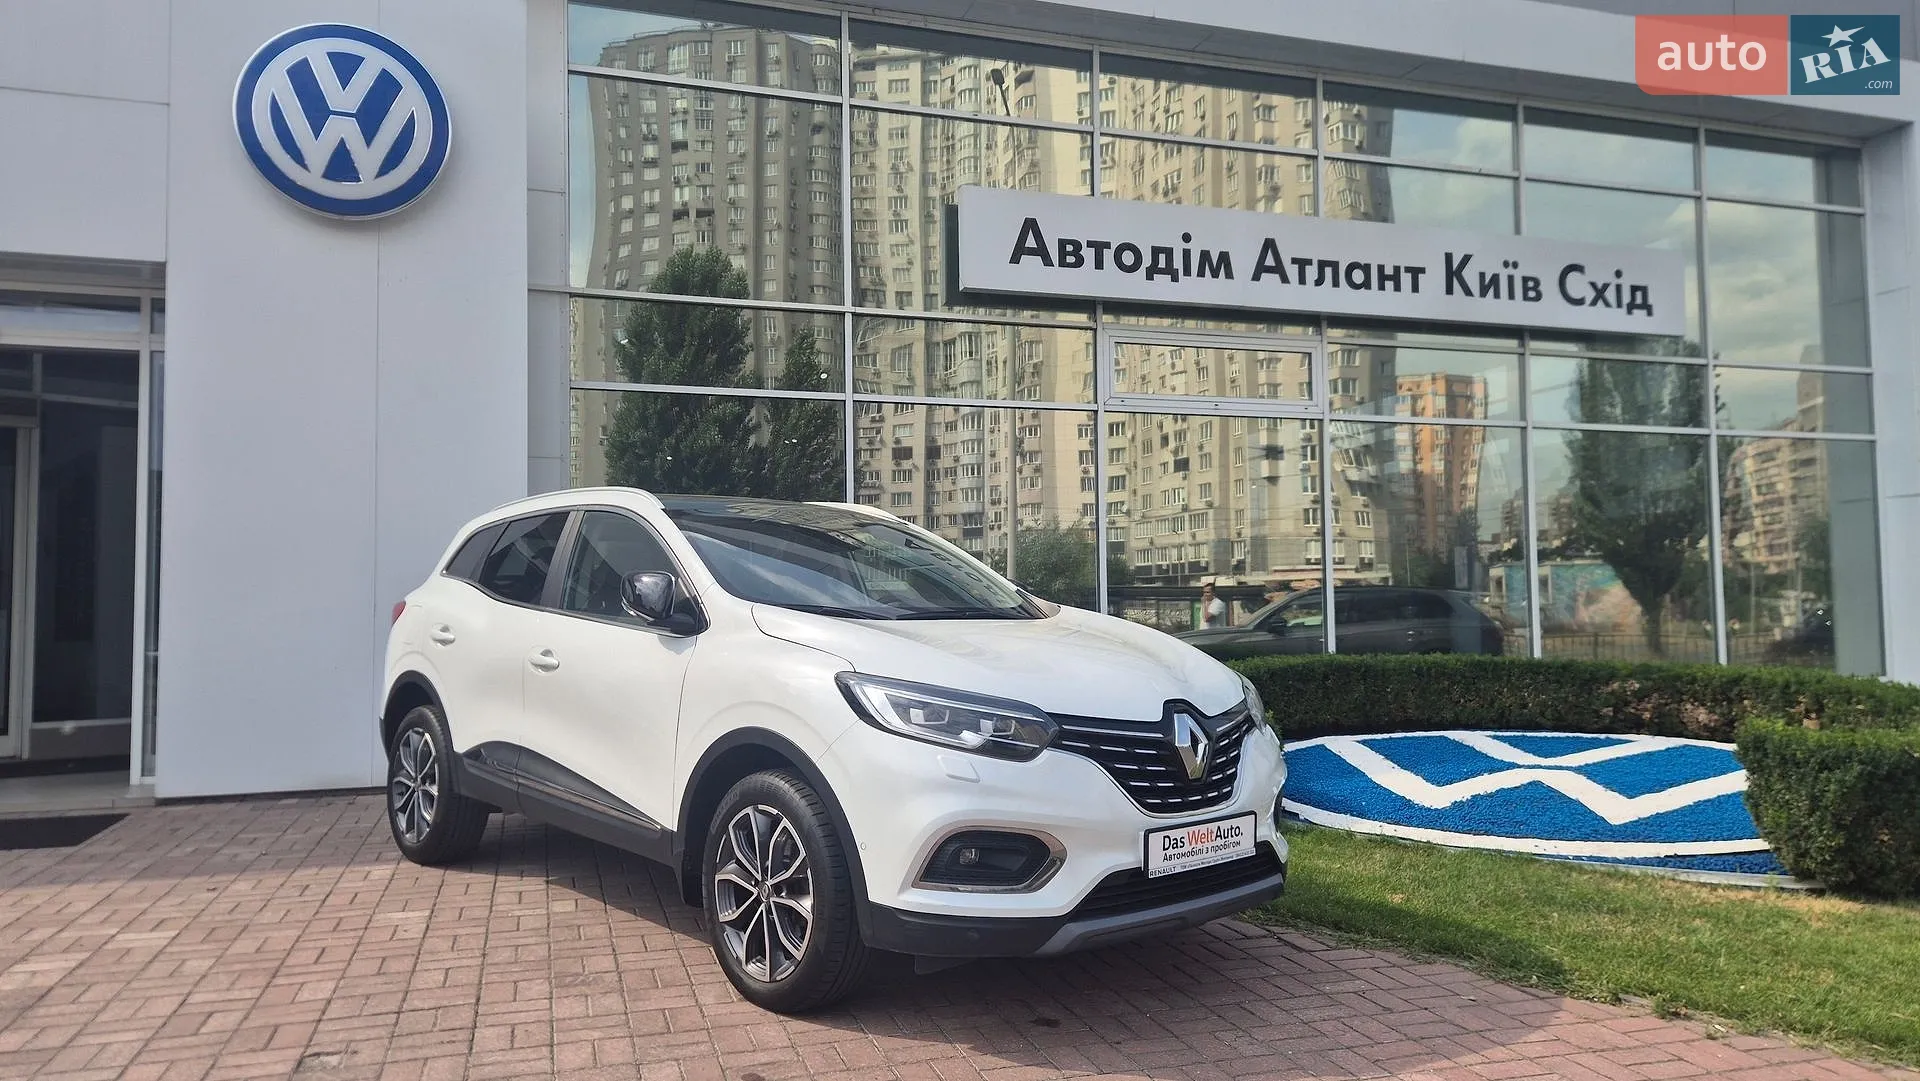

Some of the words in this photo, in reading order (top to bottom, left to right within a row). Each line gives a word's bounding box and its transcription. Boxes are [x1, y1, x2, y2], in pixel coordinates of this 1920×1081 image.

[1009, 216, 1234, 281] Автодім
[1251, 238, 1427, 294] Атлант
[1444, 252, 1543, 303] Київ
[1558, 263, 1654, 318] Схід
[1162, 835, 1185, 851] Das
[1162, 846, 1204, 862] Автомобілі
[1210, 839, 1241, 854] пробігом
[1149, 866, 1177, 877] RENAULT
